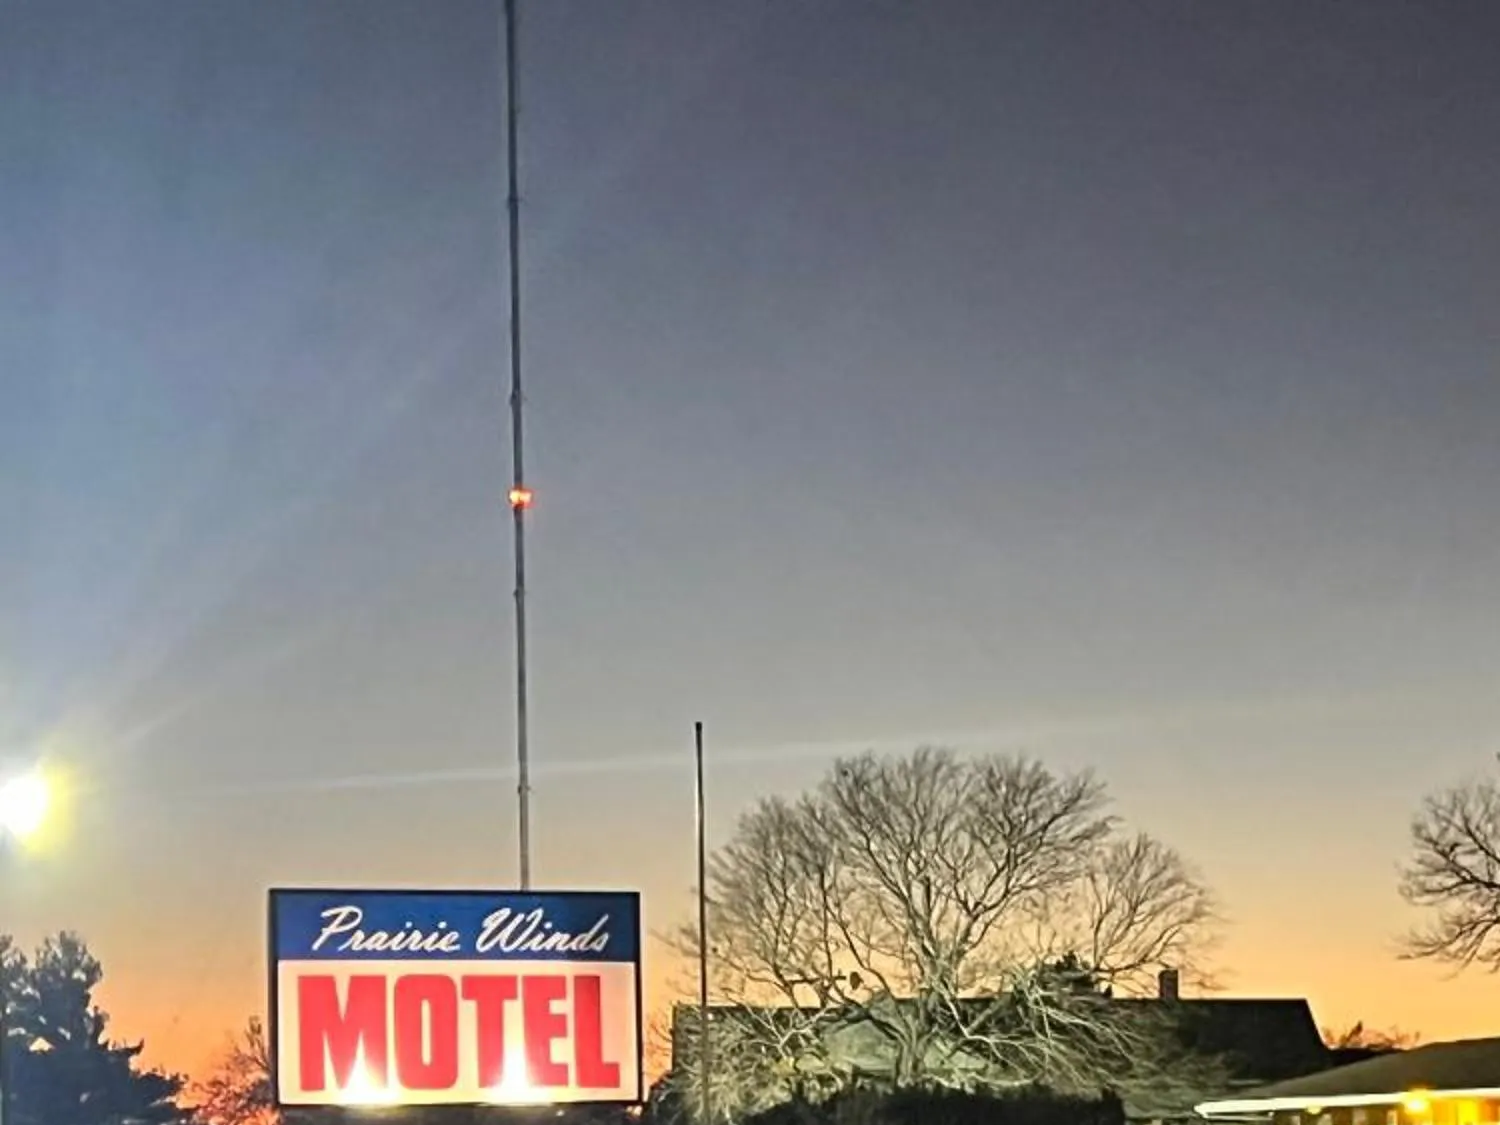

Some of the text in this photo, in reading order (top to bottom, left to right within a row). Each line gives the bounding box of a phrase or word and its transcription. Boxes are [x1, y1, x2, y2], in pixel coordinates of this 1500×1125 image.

[312, 905, 609, 953] Prairie Winds
[297, 973, 621, 1091] MOTEL
